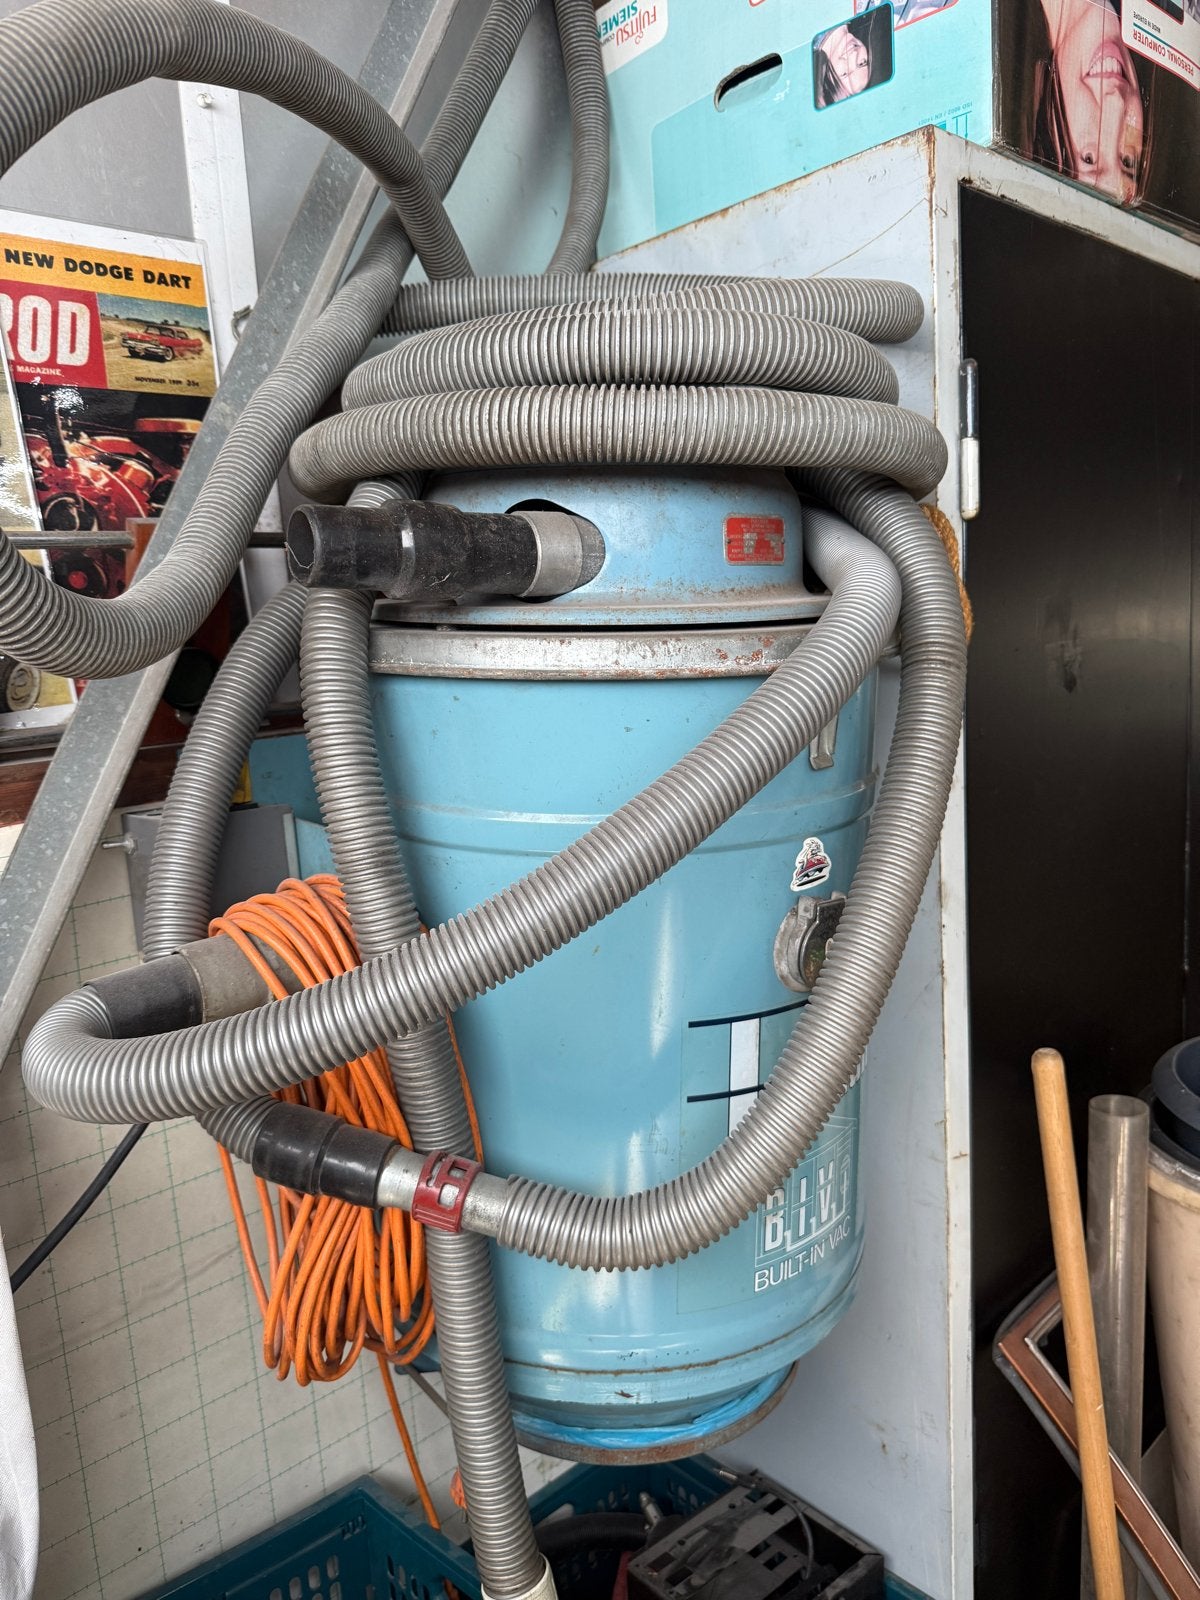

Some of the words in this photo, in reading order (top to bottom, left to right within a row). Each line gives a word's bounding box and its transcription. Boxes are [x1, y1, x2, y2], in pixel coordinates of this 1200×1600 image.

[616, 5, 657, 46] FUJITSU
[1133, 29, 1166, 56] COMPUTER
[1167, 49, 1194, 76] PERSONAL
[5, 249, 54, 269] NEW
[64, 258, 134, 282] DODGE
[143, 269, 192, 290] DART
[754, 1240, 825, 1292] BUILT-IN
[829, 1215, 851, 1250] VAC
